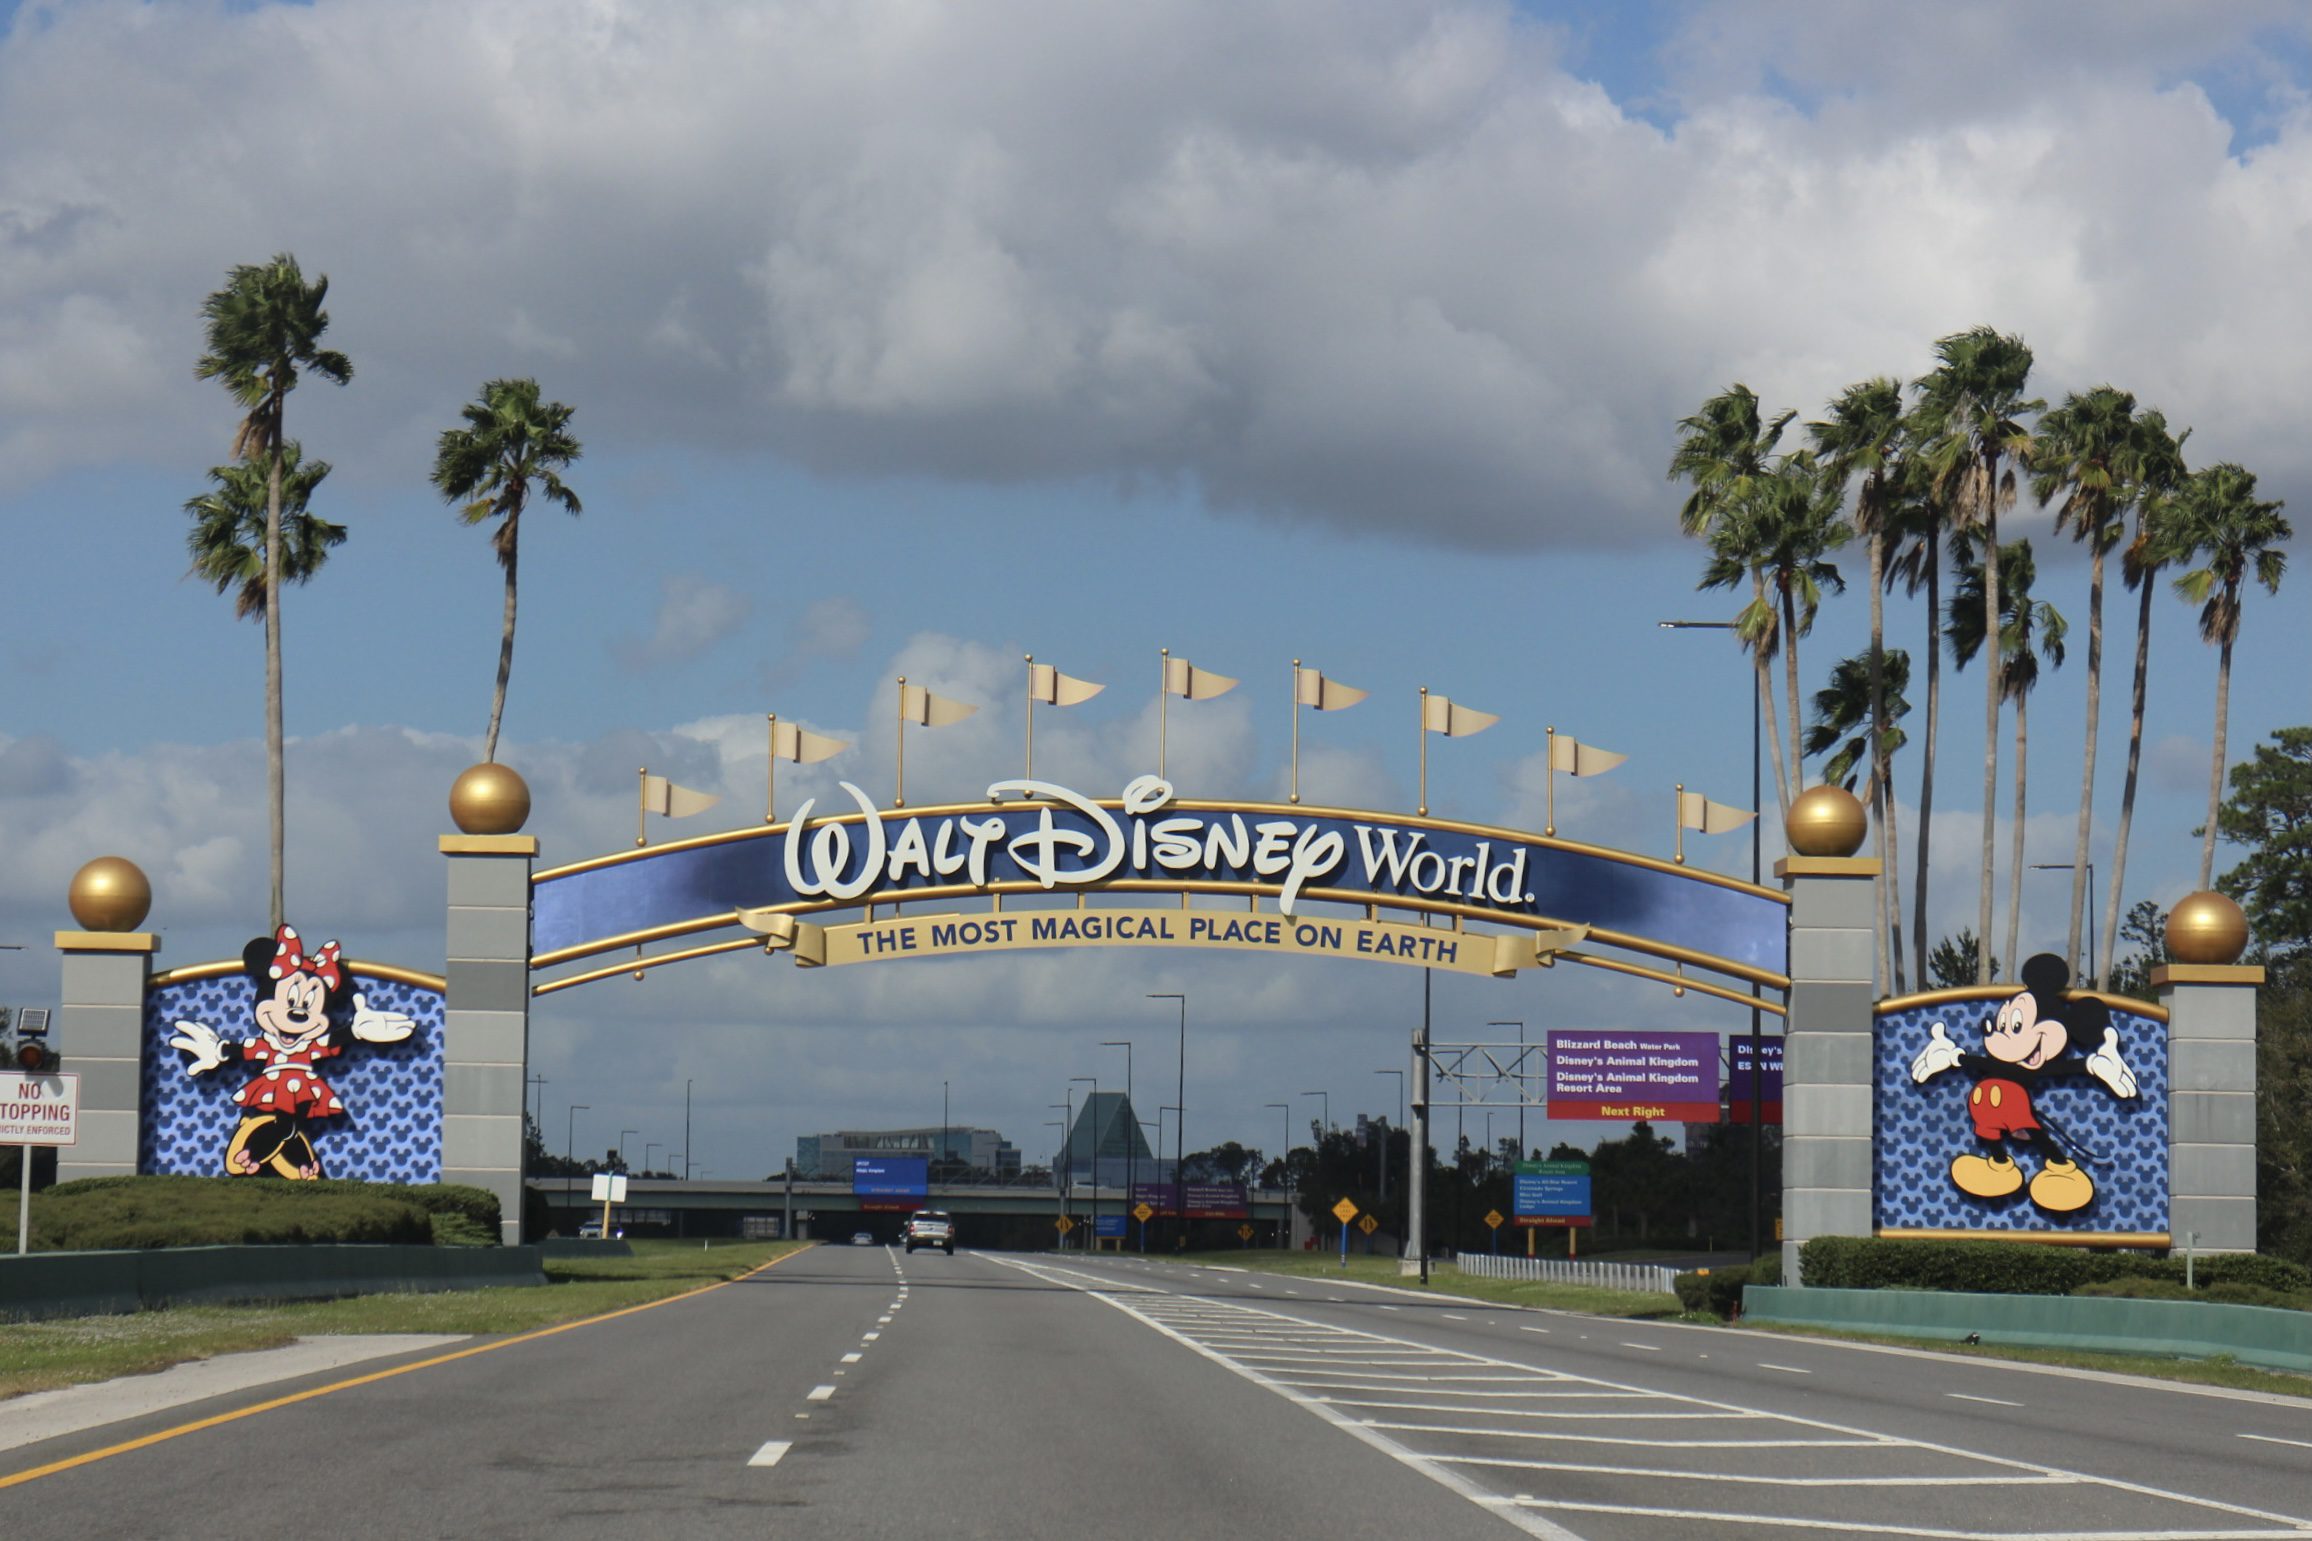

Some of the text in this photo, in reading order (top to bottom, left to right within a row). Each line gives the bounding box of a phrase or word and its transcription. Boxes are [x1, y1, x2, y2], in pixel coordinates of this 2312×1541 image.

[857, 916, 1458, 964] THE MOST MAGICAL PLACE ON EARTH
[1556, 1039, 1681, 1051] Blizzard Beach Water Park
[1556, 1055, 1699, 1068] Disney's Animal Kingdom
[1737, 1061, 1767, 1071] ESN
[1556, 1071, 1699, 1084] Disney's Animal Kingdom
[18, 1082, 41, 1100] NO
[1556, 1083, 1622, 1093] Resort Area
[0, 1103, 70, 1121] TOPPING
[1601, 1106, 1665, 1118] Next Right
[27, 1125, 71, 1136] ENFORCED
